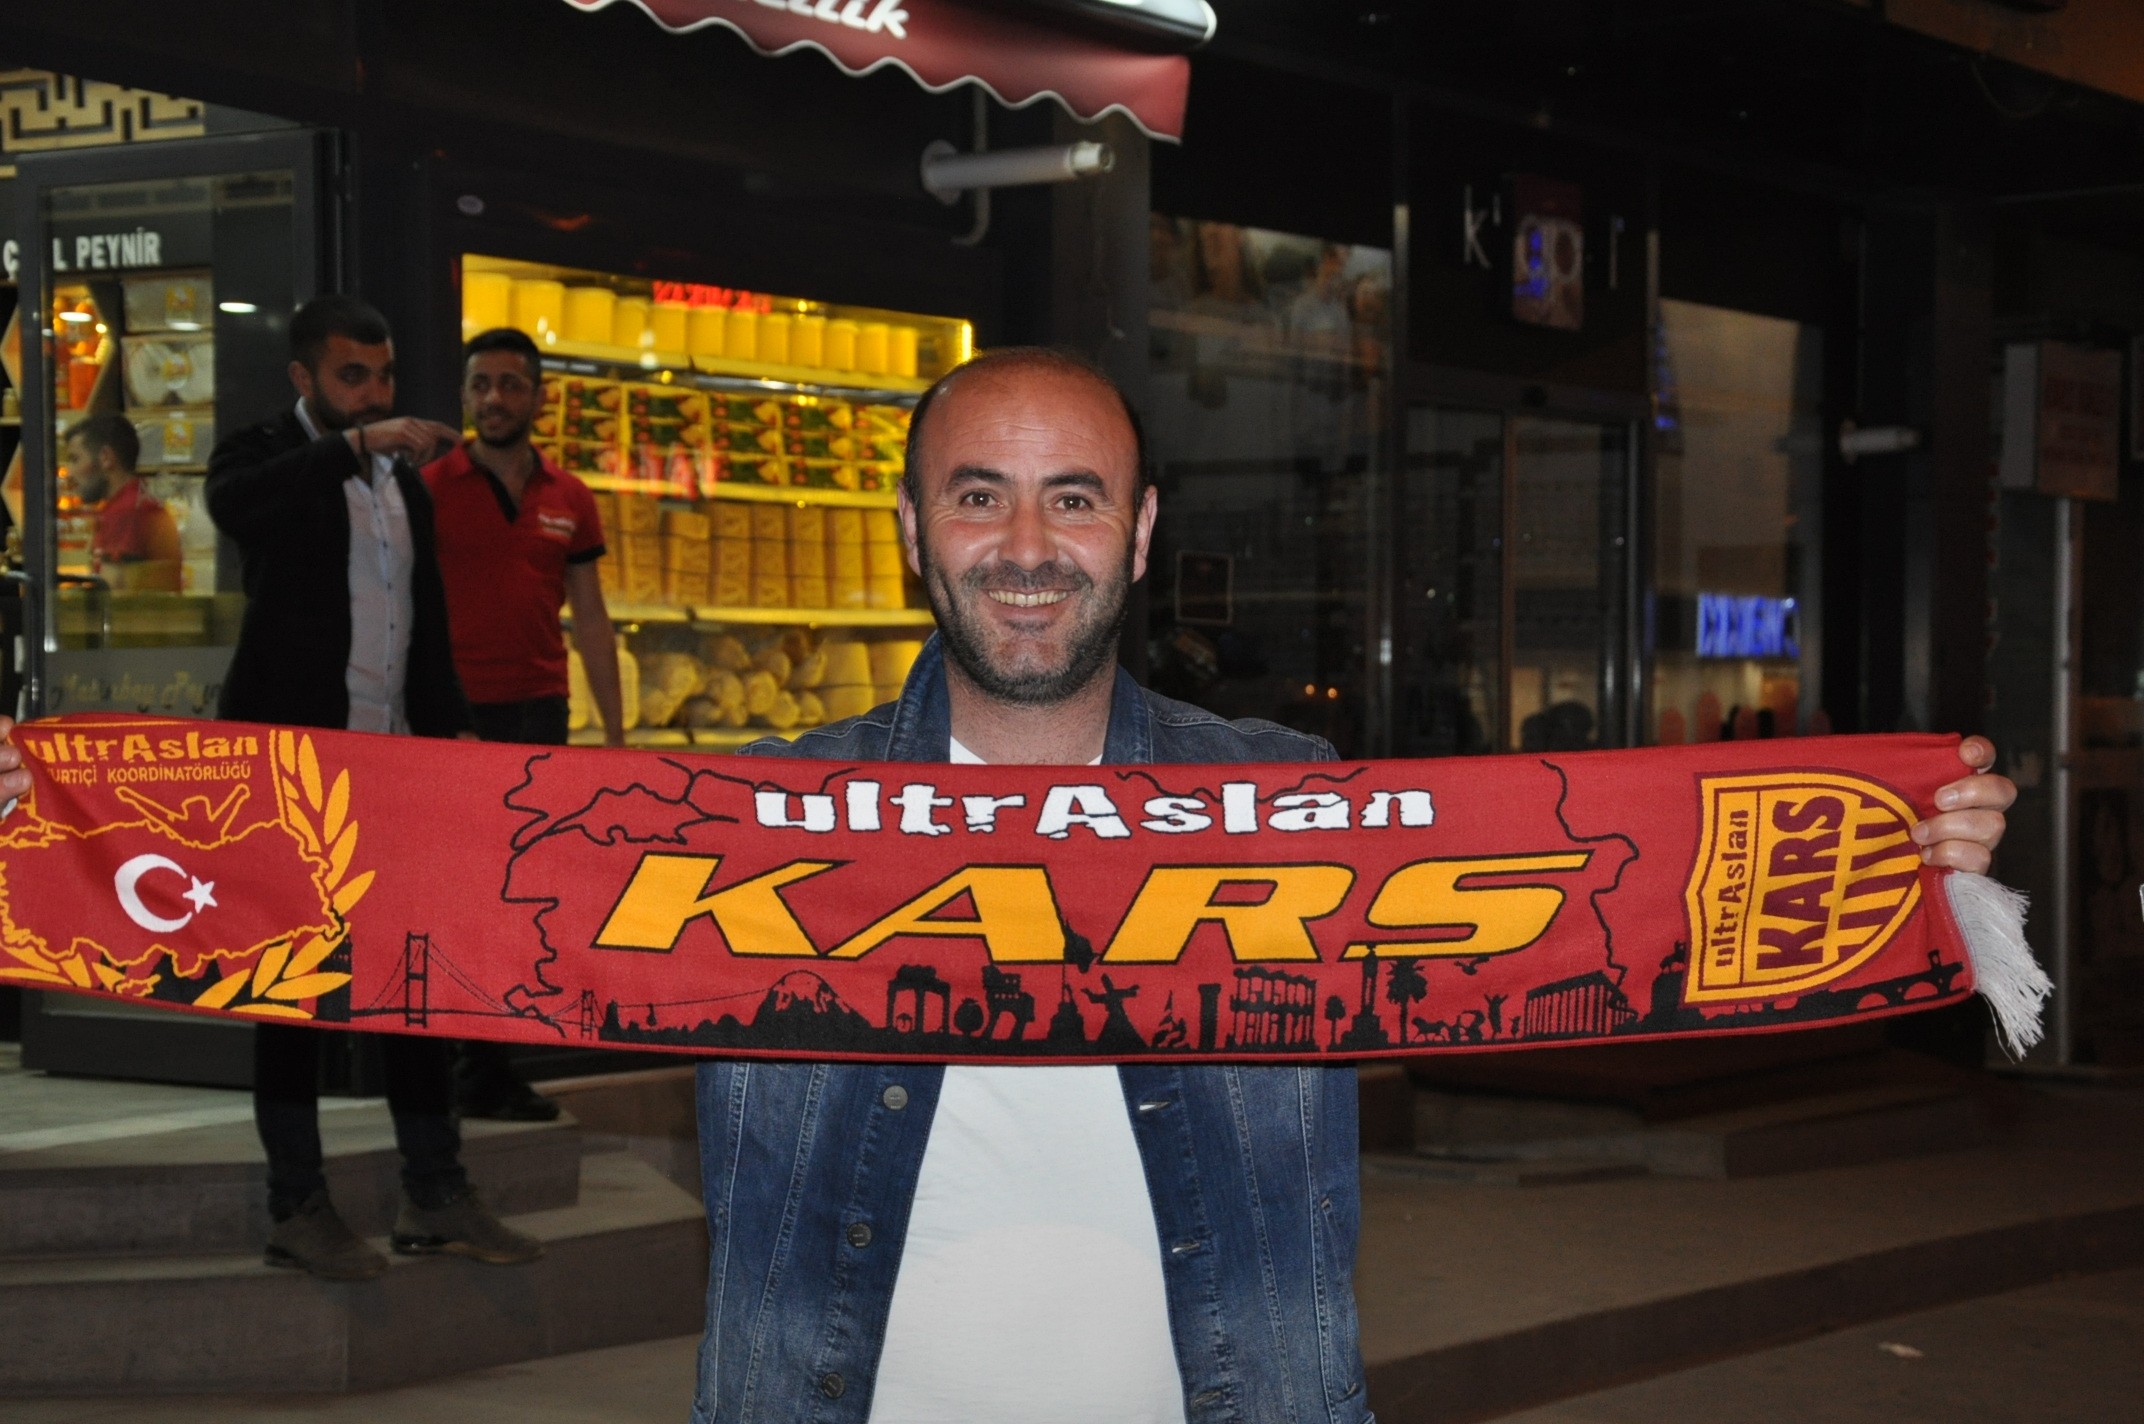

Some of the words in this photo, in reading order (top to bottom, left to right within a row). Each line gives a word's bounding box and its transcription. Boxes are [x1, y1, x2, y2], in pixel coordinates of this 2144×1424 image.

[75, 227, 161, 269] PEYNİR
[47, 764, 97, 788] URTİÇİ
[107, 760, 251, 784] KOORDİNATÖRLÜĞÜ
[754, 779, 1434, 838] ultrAslan
[590, 849, 1595, 963] KARS
[1710, 809, 1749, 968] ultrAslan
[1756, 795, 1845, 970] KARS
